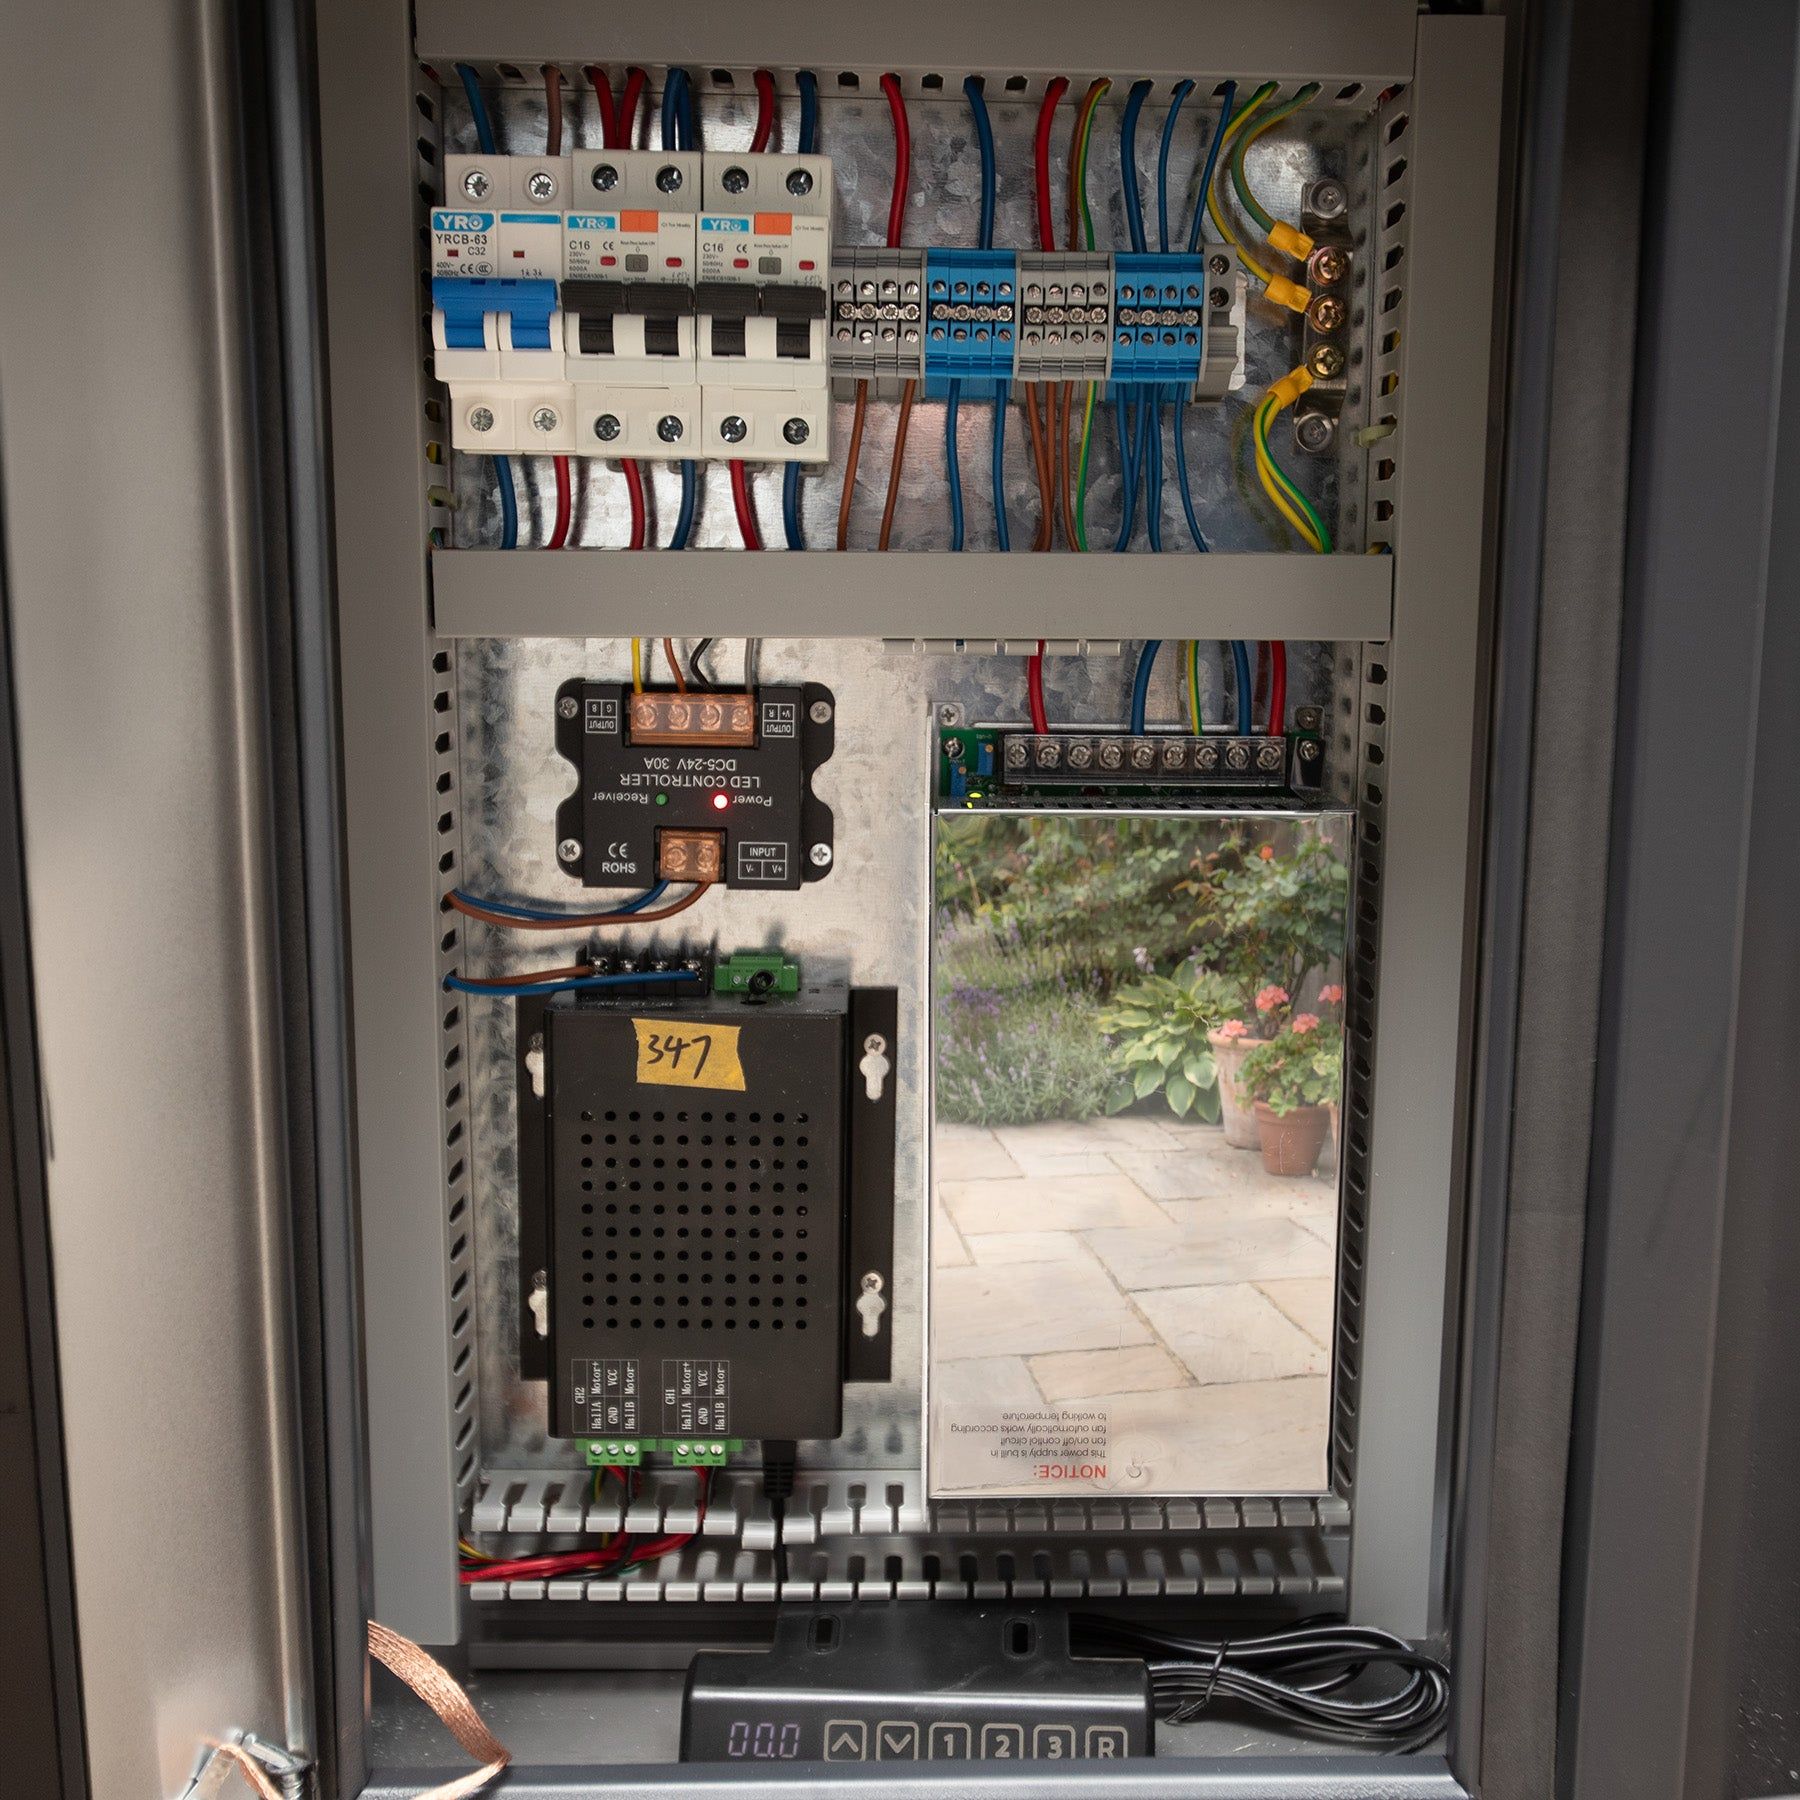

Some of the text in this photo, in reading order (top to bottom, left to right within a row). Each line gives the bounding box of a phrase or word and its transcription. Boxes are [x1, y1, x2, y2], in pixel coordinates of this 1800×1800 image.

[439, 214, 483, 230] YRO
[576, 218, 607, 229] YRO
[710, 220, 741, 231] YRO
[436, 234, 488, 245] YRCB-63
[569, 240, 590, 250] C16
[467, 247, 486, 256] C32
[703, 243, 723, 252] C16
[606, 703, 612, 713] G
[769, 709, 791, 718] V+ R
[589, 720, 615, 730] OUTPUT
[766, 724, 792, 734] OUTPUT
[643, 757, 736, 772] DC5-24V 30A
[620, 773, 761, 789] LED CONTROLLER
[592, 792, 648, 804] Receiver
[732, 794, 772, 806] Power
[749, 847, 776, 857] INPUT
[602, 863, 636, 874] ROHS
[745, 865, 783, 874] V- V+
[646, 1034, 712, 1080] 347
[591, 1361, 602, 1395] Motor+
[607, 1369, 618, 1387] VCC
[624, 1361, 635, 1395] Motor-
[681, 1362, 692, 1395] Motor+
[698, 1369, 708, 1387] VCC
[715, 1362, 725, 1396] Motor-
[574, 1387, 585, 1405] CH2
[665, 1389, 675, 1405] CH1
[591, 1401, 602, 1430] HallA
[608, 1407, 618, 1425] GND
[625, 1401, 635, 1430] HallB
[681, 1402, 692, 1430] HallA
[698, 1407, 708, 1425] GND
[715, 1402, 725, 1431] HallB
[950, 1423, 1107, 1433] fan automatically works according
[1000, 1437, 1028, 1446] circuit
[1061, 1437, 1089, 1446] on/off
[1091, 1437, 1107, 1446] fan
[990, 1448, 1106, 1458] This power supply is built in
[1033, 1464, 1107, 1479] NOTICE:
[728, 1721, 800, 1758] 00.0
[944, 1734, 1115, 1759] 1 2 3 R
